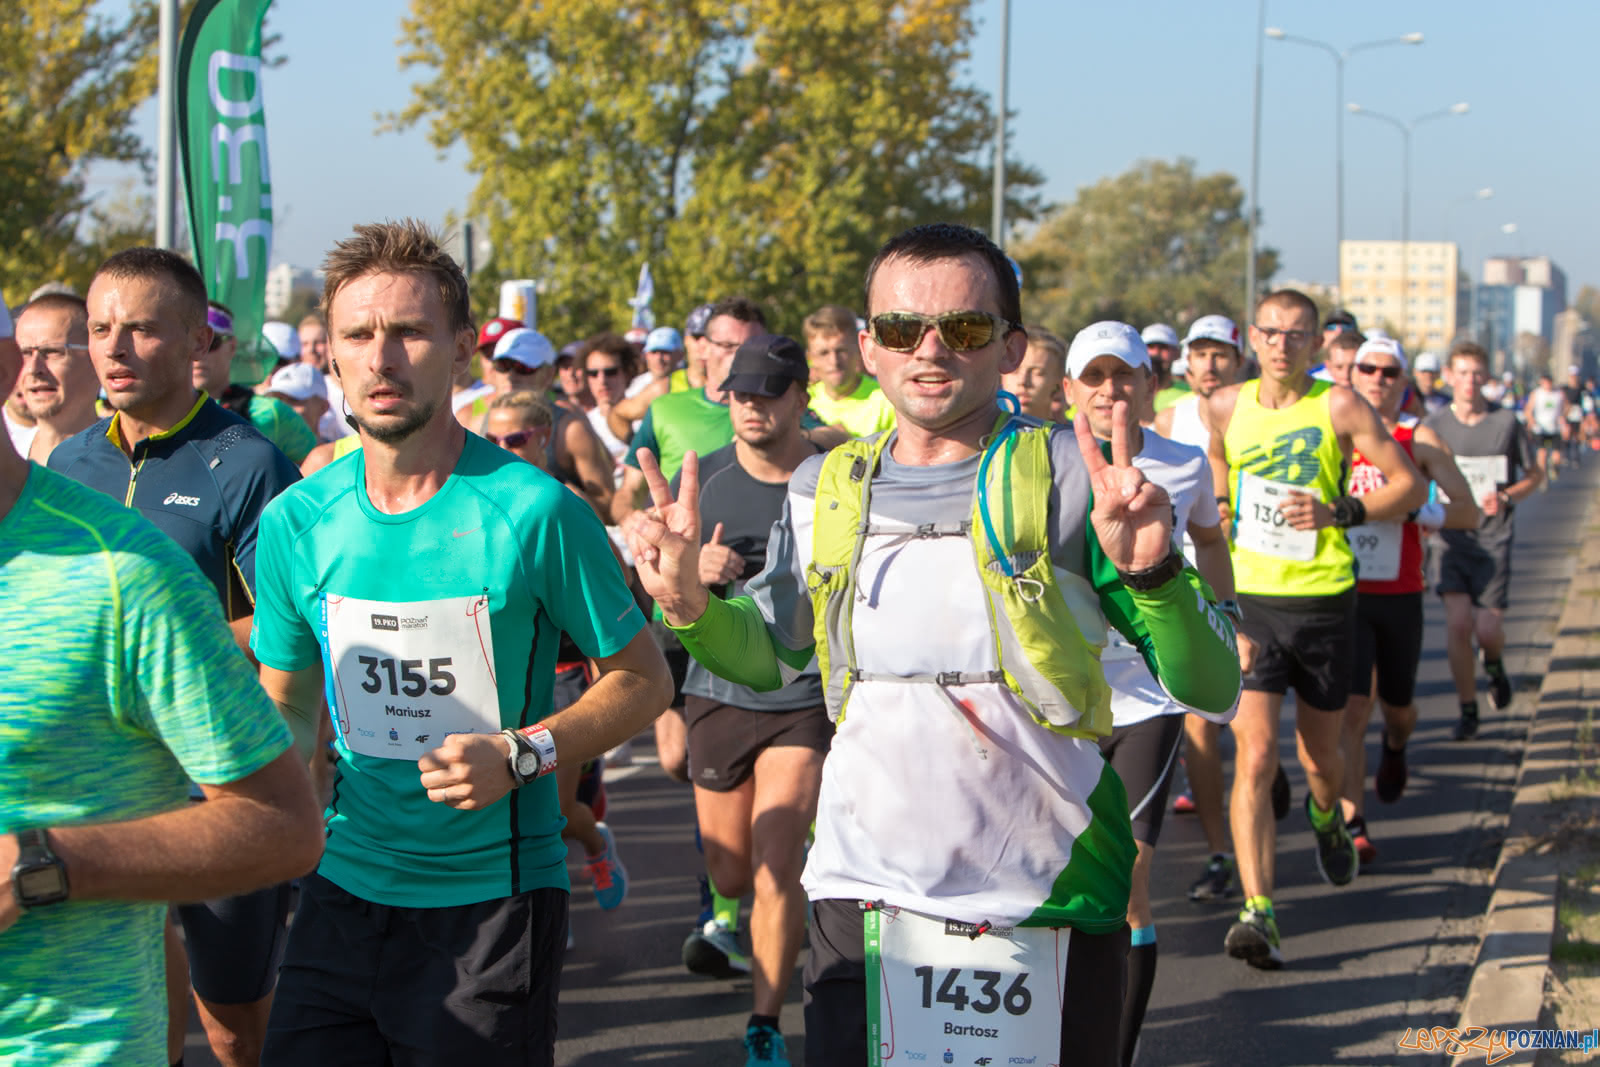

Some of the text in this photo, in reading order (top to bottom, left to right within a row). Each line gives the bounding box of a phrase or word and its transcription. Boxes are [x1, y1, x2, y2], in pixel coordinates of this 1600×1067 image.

[1253, 503, 1295, 527] 130
[374, 618, 397, 628] 19.PKO
[358, 655, 456, 698] 3155
[385, 704, 432, 718] Mariusz
[415, 734, 430, 744] 4F
[914, 965, 1033, 1016] 1436
[944, 1022, 999, 1038] Bartosz
[974, 1056, 993, 1067] 4F
